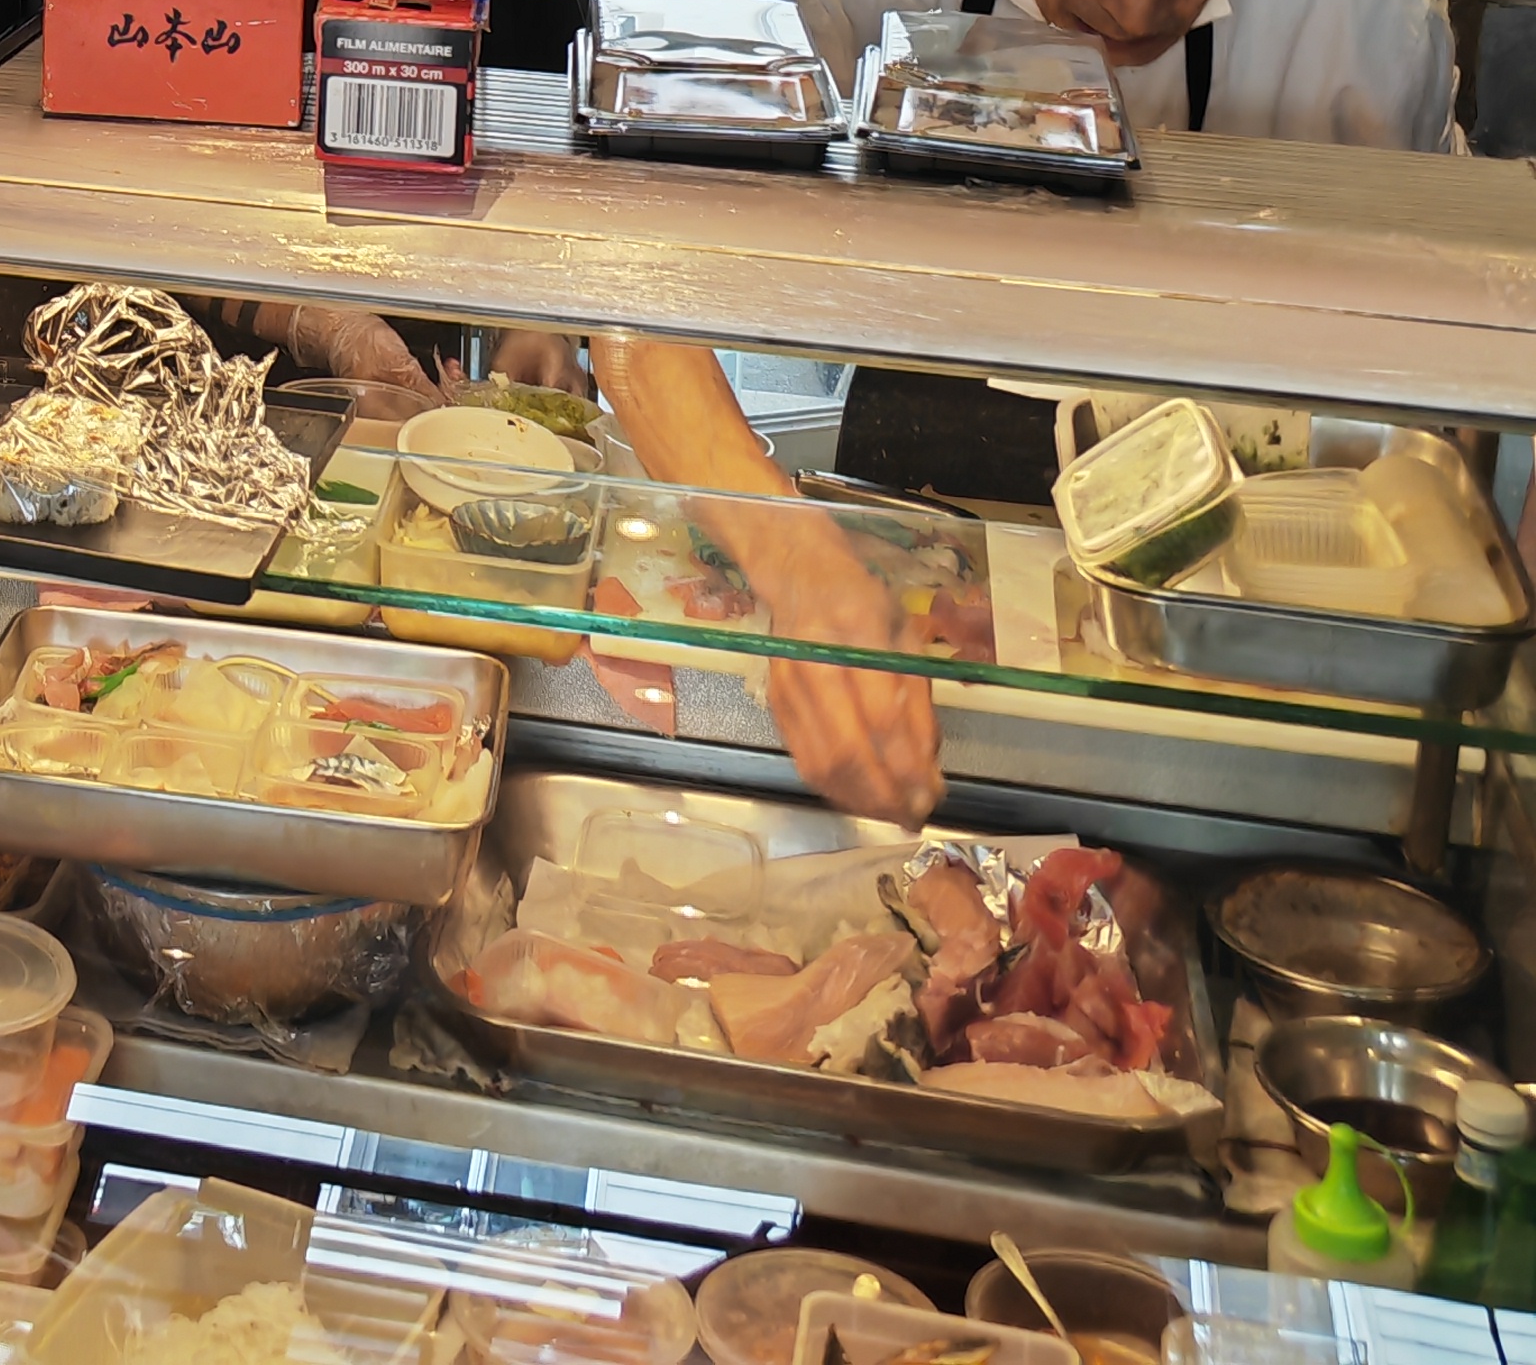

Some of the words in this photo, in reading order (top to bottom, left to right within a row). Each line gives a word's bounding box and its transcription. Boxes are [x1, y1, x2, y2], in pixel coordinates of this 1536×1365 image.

[336, 37, 366, 50] FILM
[368, 40, 453, 57] ALIMENTAIRE
[343, 60, 369, 73] 300
[372, 64, 386, 76] m
[388, 67, 397, 76] x
[400, 65, 418, 78] 30
[420, 69, 443, 80] cm
